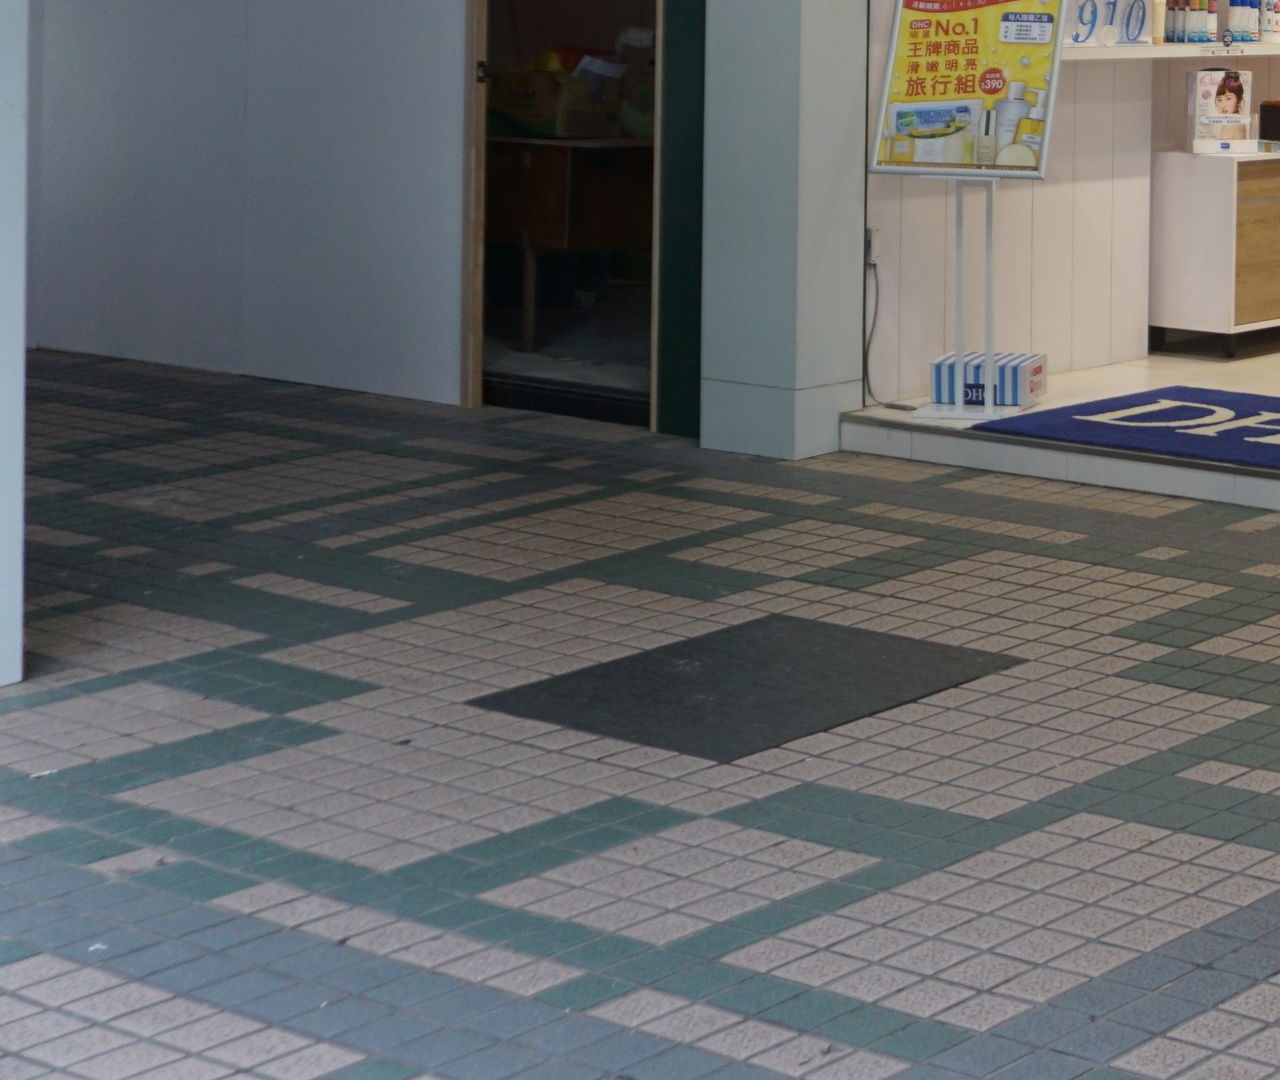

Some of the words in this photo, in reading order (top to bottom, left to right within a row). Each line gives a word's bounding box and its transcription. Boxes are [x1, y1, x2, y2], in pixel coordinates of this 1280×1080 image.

[911, 21, 930, 29] DHC
[935, 19, 979, 37] No.1
[907, 39, 979, 57] 王牌商品
[907, 58, 977, 73] 滑嫩明亮
[905, 74, 976, 97] 旅行組
